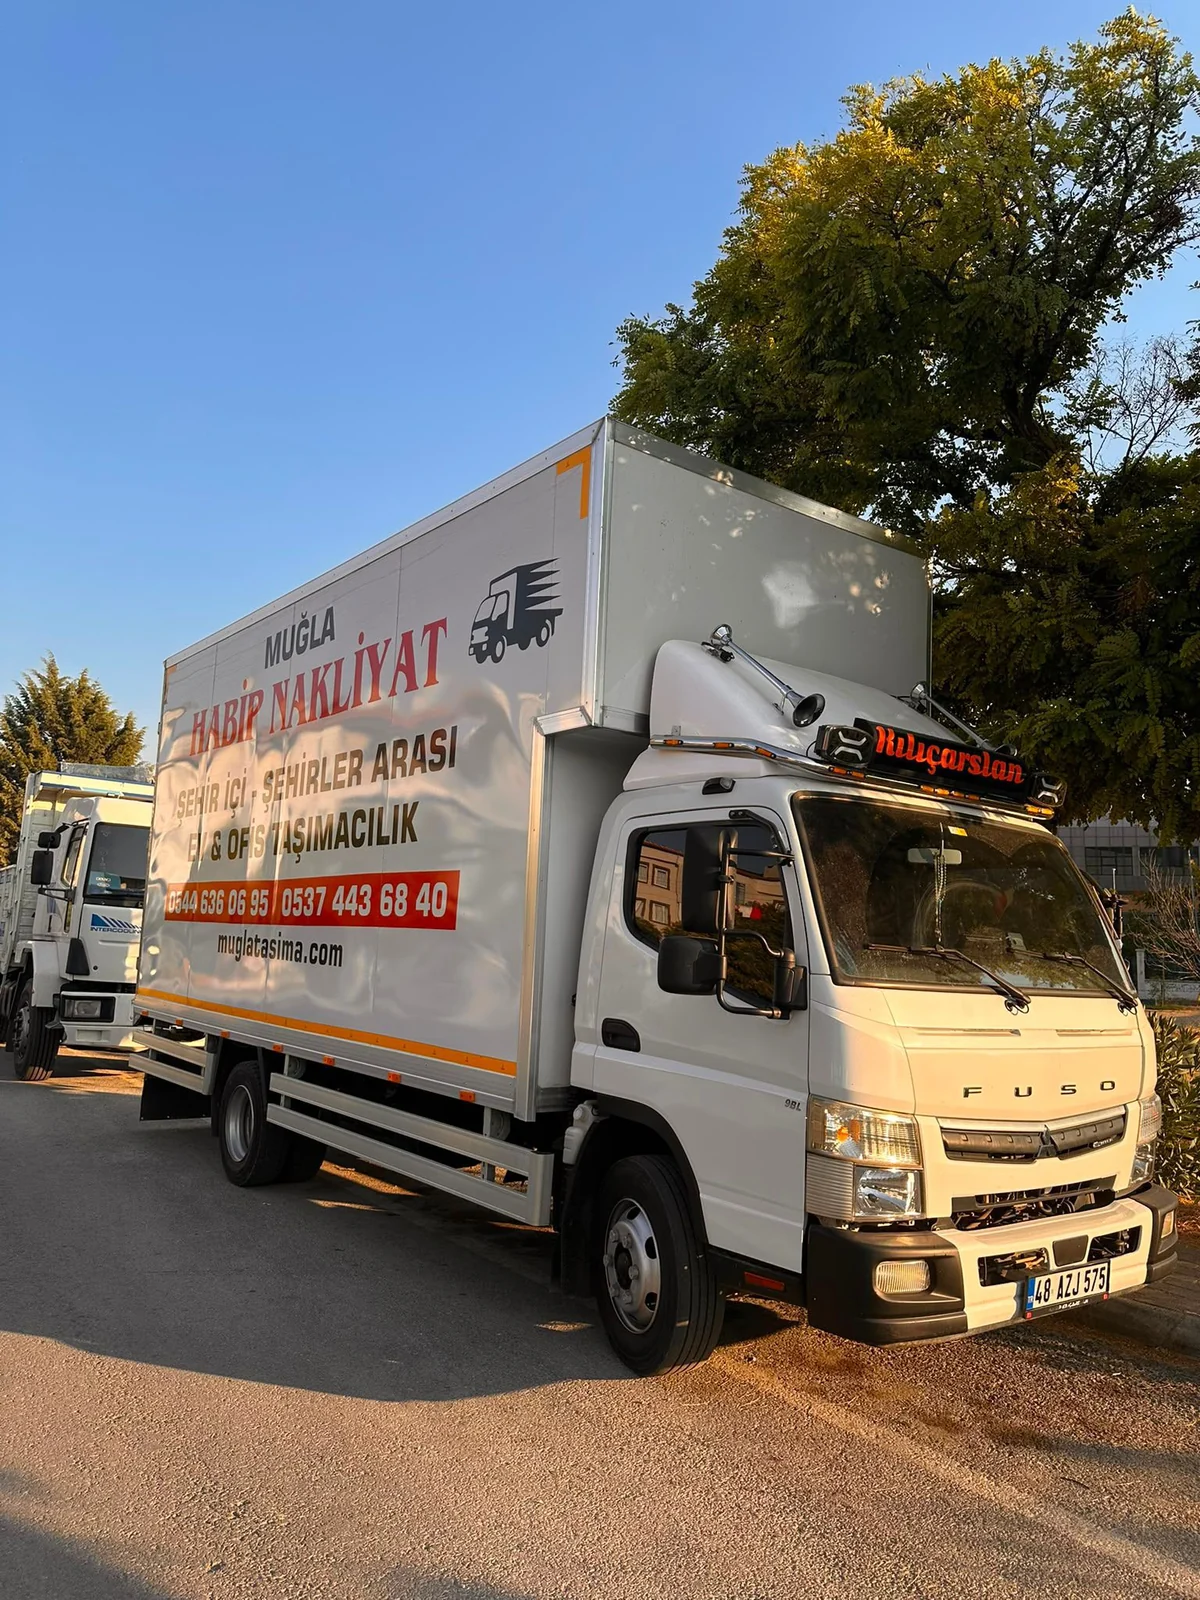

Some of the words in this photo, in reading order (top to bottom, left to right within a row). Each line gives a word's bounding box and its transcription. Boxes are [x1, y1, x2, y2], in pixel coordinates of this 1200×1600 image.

[265, 606, 335, 669] MUĞLA
[190, 678, 264, 756] HABİP
[269, 617, 447, 734] NAKLİYAT
[177, 777, 220, 827] ŞEHİR
[224, 767, 247, 819] İÇİ
[262, 749, 364, 813] ŞEHİRLER
[371, 725, 458, 783] ARASI
[876, 725, 1024, 784] Kılıçarslan
[188, 832, 208, 862] EV
[211, 830, 221, 861] &
[227, 817, 265, 860] OFİS
[272, 801, 420, 864] TAŞIMACILIK
[168, 889, 198, 914] 0544
[200, 889, 225, 915] 636
[228, 888, 247, 916] 06
[250, 888, 269, 917] 95
[281, 886, 327, 917] 0537
[331, 883, 372, 917] 443
[380, 882, 408, 917] 68
[415, 881, 448, 918] 40
[217, 929, 343, 968] muglatasima.com
[784, 1098, 802, 1112] 9BL
[963, 1080, 1115, 1098] FUSO
[1035, 1277, 1051, 1304] 48
[1056, 1271, 1081, 1300] AZJ
[1083, 1266, 1107, 1294] 575
